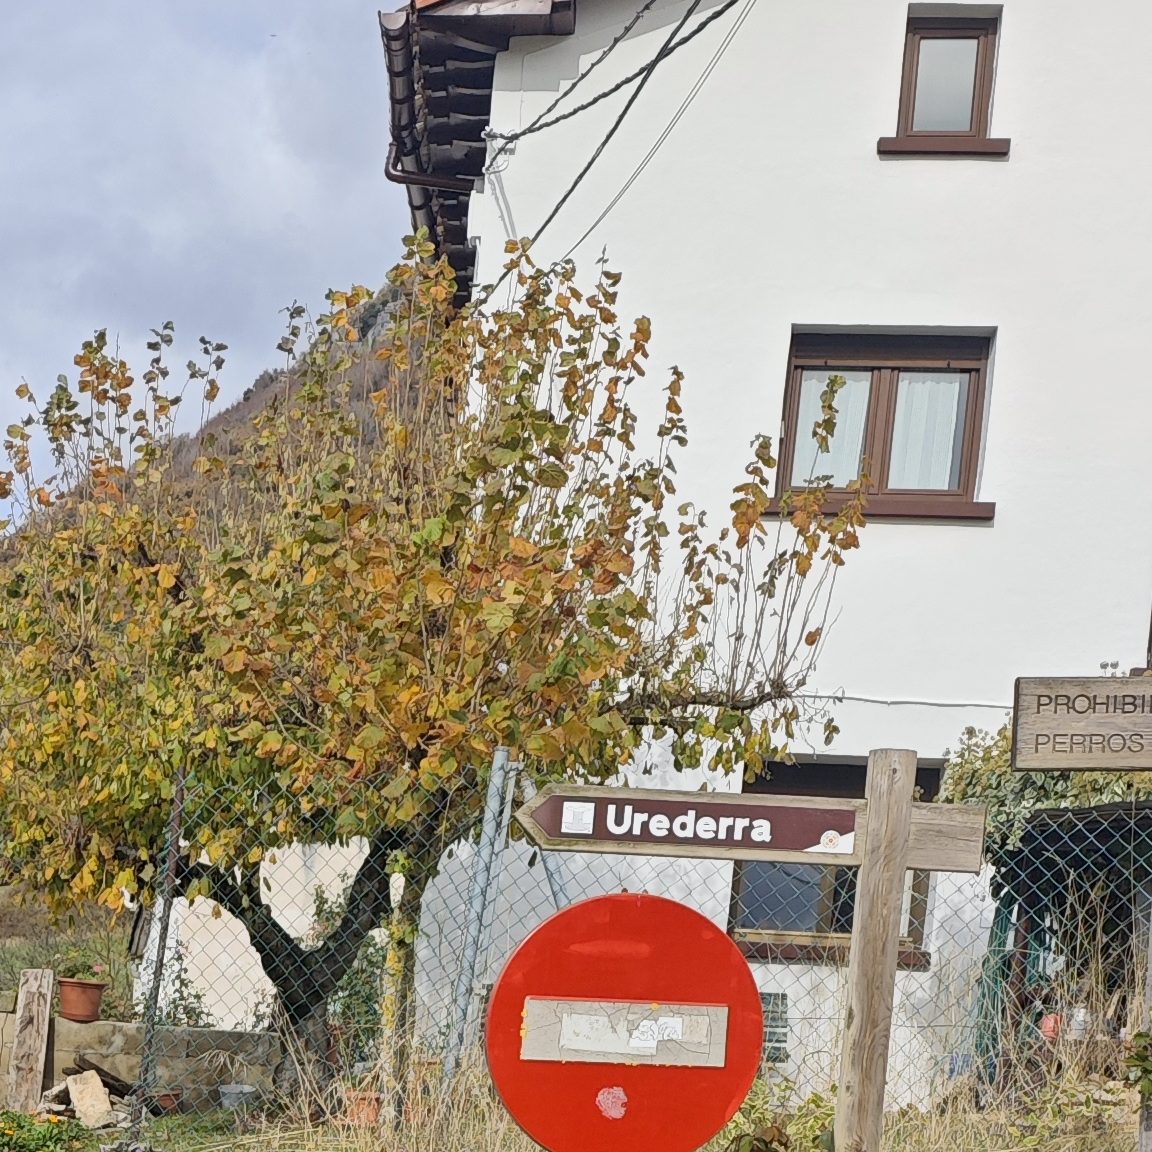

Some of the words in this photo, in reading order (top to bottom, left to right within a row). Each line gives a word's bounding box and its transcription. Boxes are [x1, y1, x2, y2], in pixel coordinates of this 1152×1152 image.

[1036, 693, 1152, 715] PROHIBI
[1034, 733, 1145, 754] PERROS
[606, 803, 773, 843] Urederra
